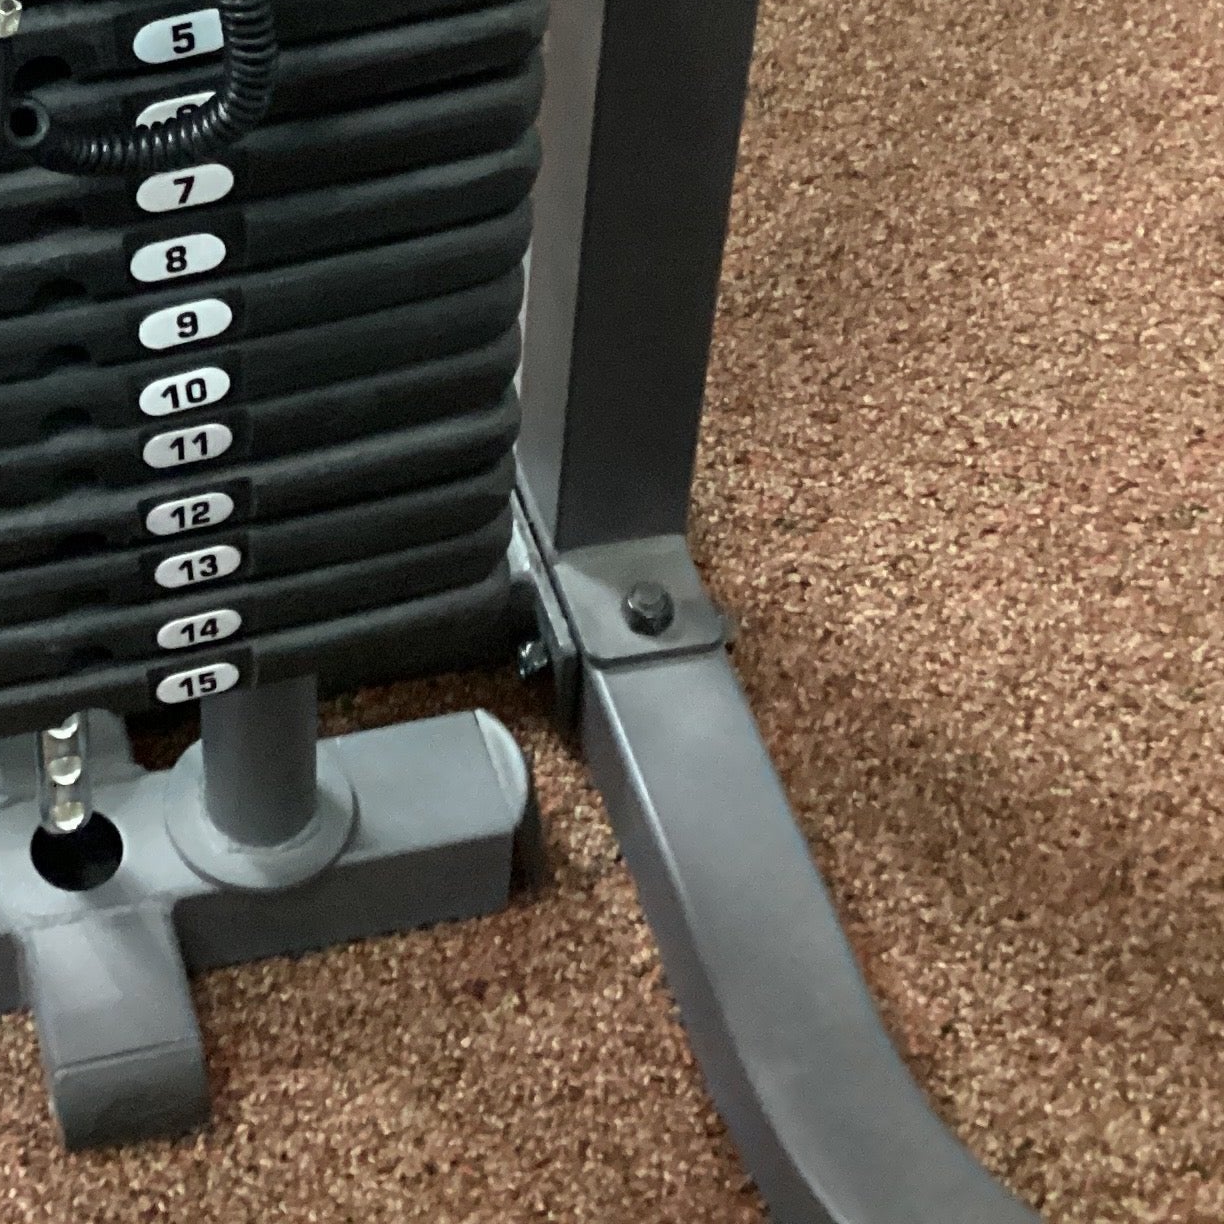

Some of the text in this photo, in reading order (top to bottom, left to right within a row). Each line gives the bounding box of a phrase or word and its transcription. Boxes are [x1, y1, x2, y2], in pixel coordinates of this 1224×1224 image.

[171, 22, 195, 54] 5
[173, 175, 195, 205] 7
[165, 245, 187, 273] 8
[177, 311, 198, 338] 9
[161, 378, 207, 409] 10
[169, 432, 208, 460] 11
[170, 501, 210, 528] 12
[178, 554, 218, 581] 13
[180, 618, 219, 643] 14
[178, 672, 217, 697] 15
